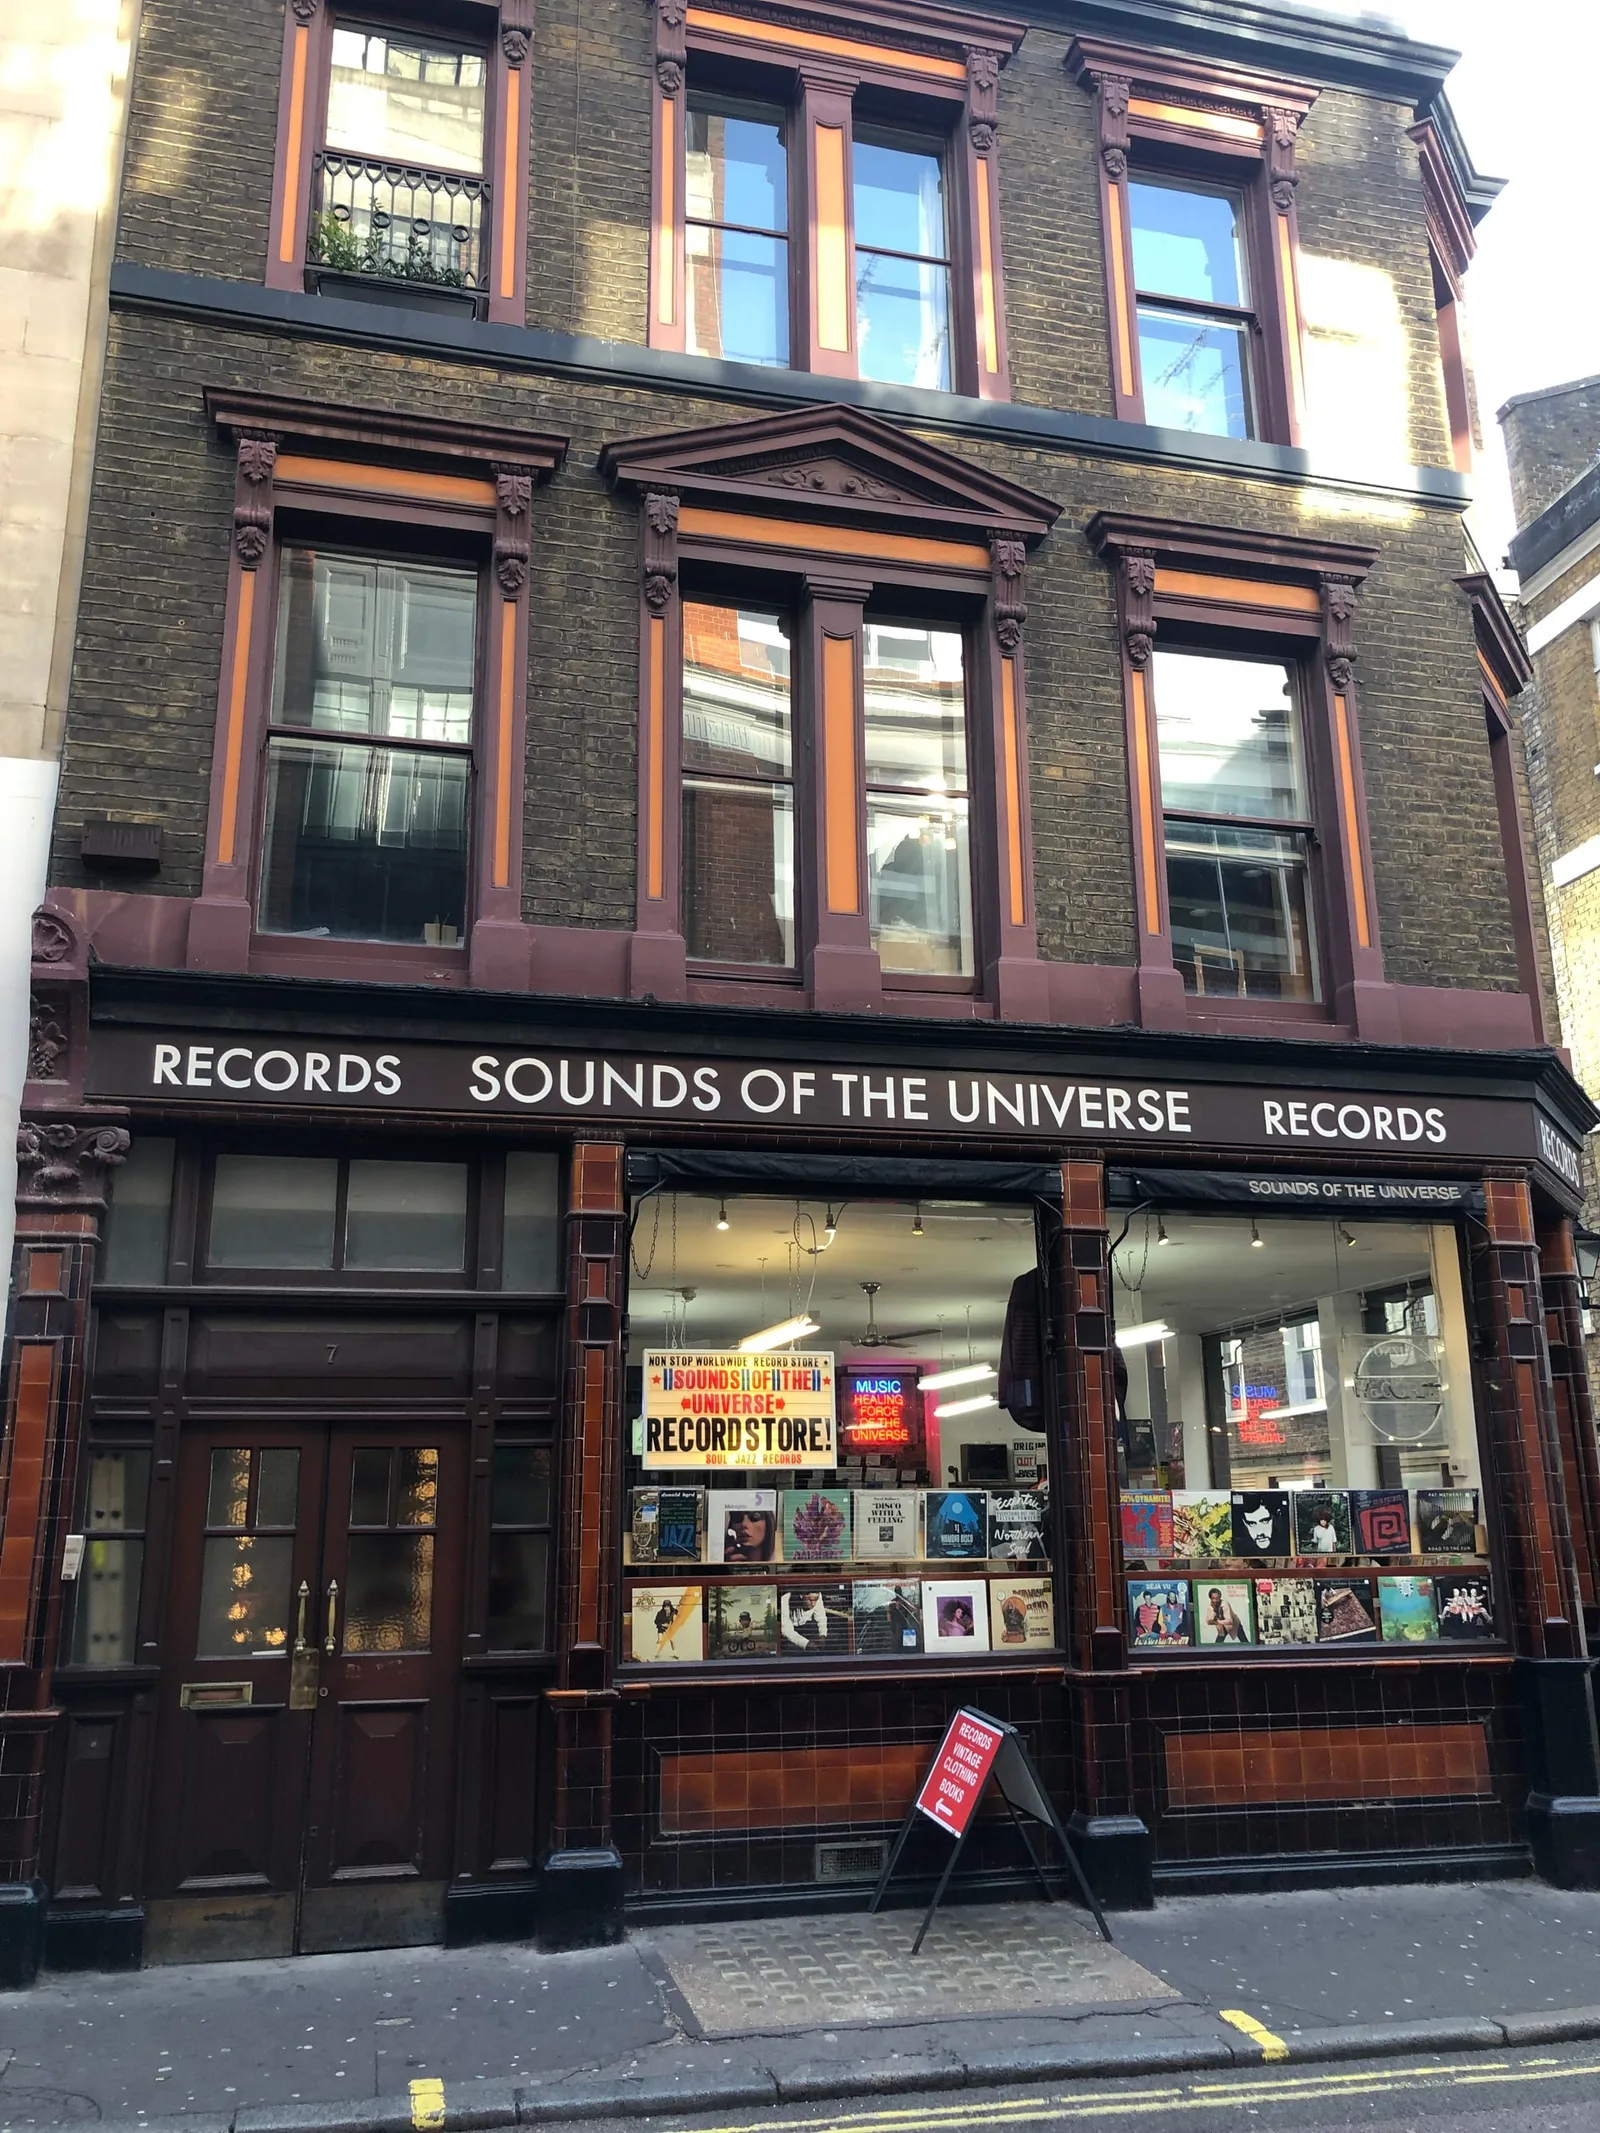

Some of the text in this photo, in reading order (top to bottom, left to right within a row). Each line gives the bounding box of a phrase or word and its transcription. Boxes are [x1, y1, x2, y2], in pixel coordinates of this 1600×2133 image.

[153, 1044, 402, 1096] RECORDS
[470, 1055, 1192, 1134] SOUNDS OF THE UNIVERSE
[1264, 1100, 1446, 1143] RECORDS
[1540, 1118, 1580, 1188] RECORDS
[1249, 1180, 1462, 1200] SOUNDS OF THE UNIVERSE
[326, 1344, 339, 1364] 7
[649, 1356, 819, 1368] NON STOP WORLDWIDE RECORD STORE
[673, 1369, 812, 1391] SOUNDS OF THE
[856, 1380, 901, 1394] MUSIC
[854, 1394, 904, 1406] HEALING
[860, 1406, 899, 1417] FORCE
[877, 1417, 901, 1428] THE
[852, 1429, 909, 1441] UNIVERSE
[705, 1453, 802, 1465] SOUL JAZZ RECORDS
[660, 1525, 694, 1548] JAZZ
[994, 1528, 1044, 1541] Northern
[1008, 1541, 1032, 1556] Soul
[959, 1722, 993, 1750] RECORDS
[953, 1742, 983, 1769] VINTAGE
[943, 1756, 978, 1786] CLOTHING
[939, 1778, 965, 1803] BOOKS
